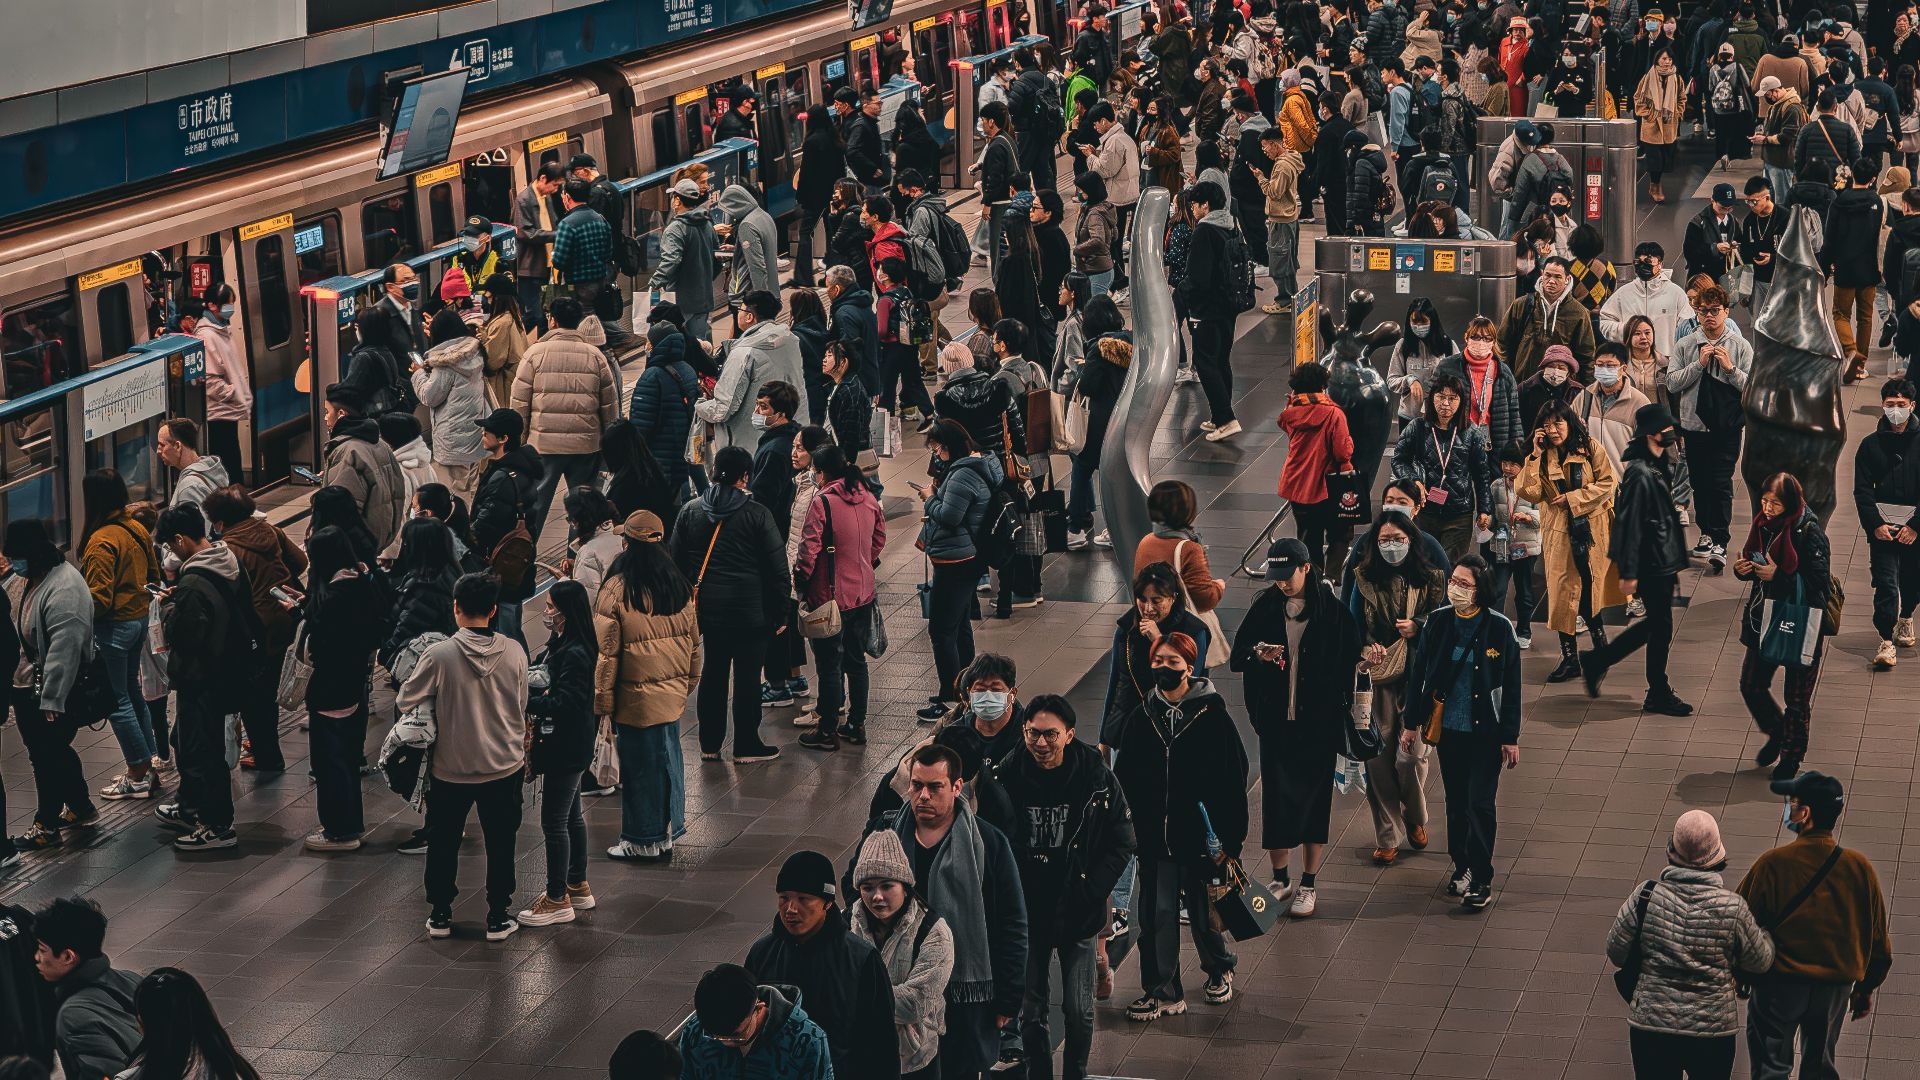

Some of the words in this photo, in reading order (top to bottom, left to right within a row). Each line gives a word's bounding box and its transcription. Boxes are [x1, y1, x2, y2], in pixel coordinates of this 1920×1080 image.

[189, 92, 233, 129] 市政府
[188, 129, 206, 143] TAIPEI
[206, 126, 220, 138] CITY
[220, 122, 235, 135] HALL
[348, 296, 355, 316] 3
[196, 350, 204, 372] 3
